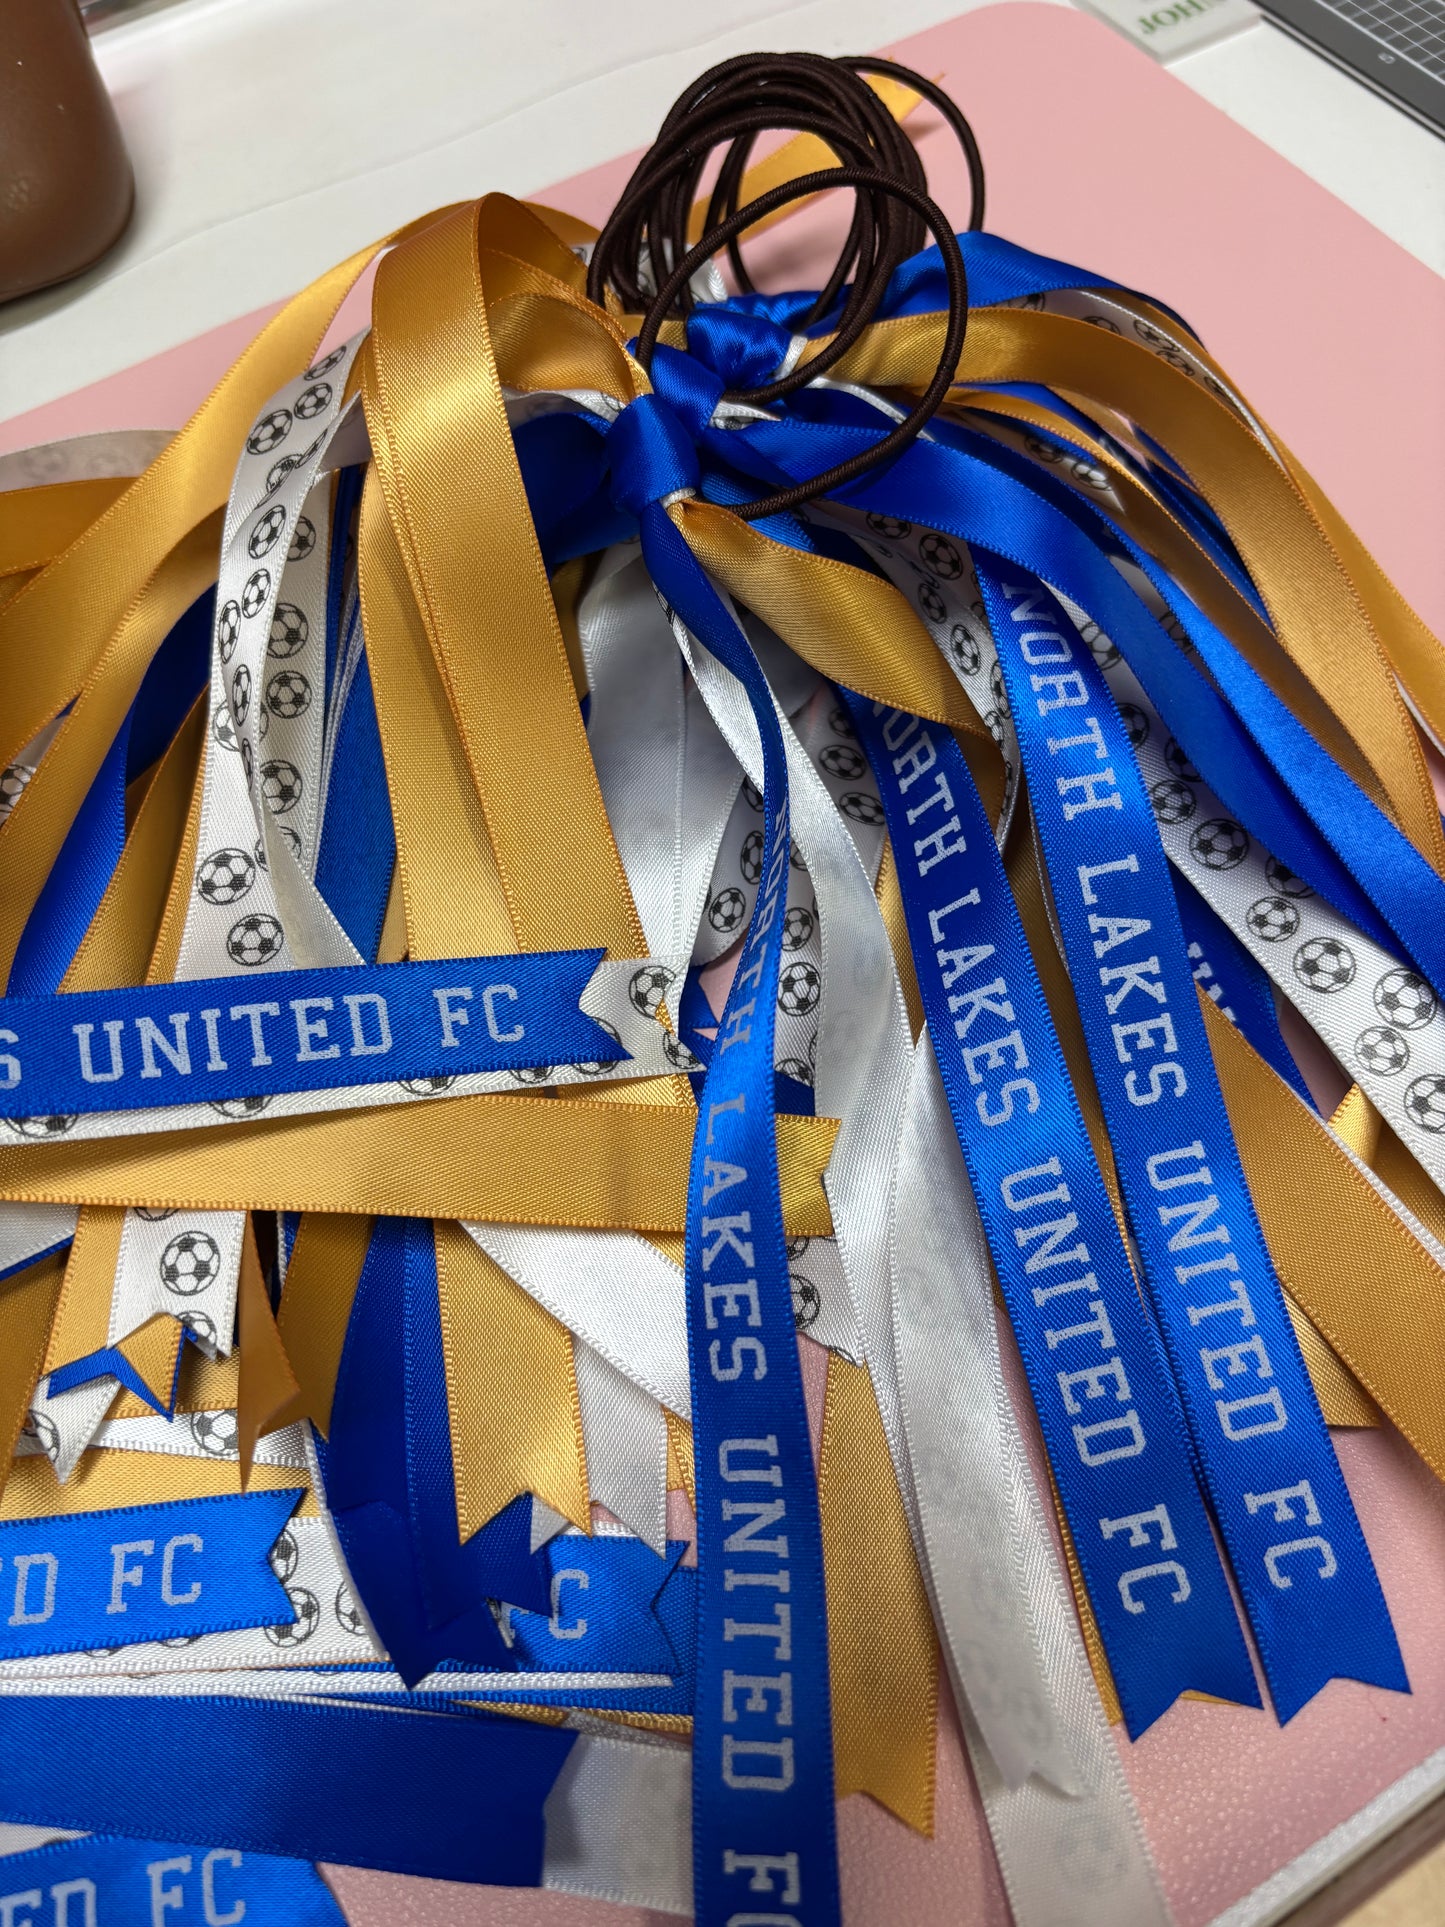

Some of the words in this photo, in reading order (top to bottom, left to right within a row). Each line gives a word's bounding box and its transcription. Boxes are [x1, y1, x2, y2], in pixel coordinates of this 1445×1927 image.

[72, 992, 393, 1084] UNITED
[433, 984, 526, 1049] FC
[720, 795, 787, 1056] NORTH
[873, 702, 967, 877] ORTH
[929, 887, 1040, 1127] LAKES
[1000, 1157, 1146, 1467] UNITED
[1101, 1503, 1192, 1614] FC
[1001, 582, 1123, 821] NORTH
[1077, 853, 1188, 1107] LAKES
[1147, 1140, 1288, 1442] UNITED
[1244, 1480, 1338, 1590] FC
[701, 1093, 768, 1383] LAKES
[106, 1533, 204, 1615] FC
[718, 1434, 796, 1791] UNITED
[146, 1848, 246, 1927] FC
